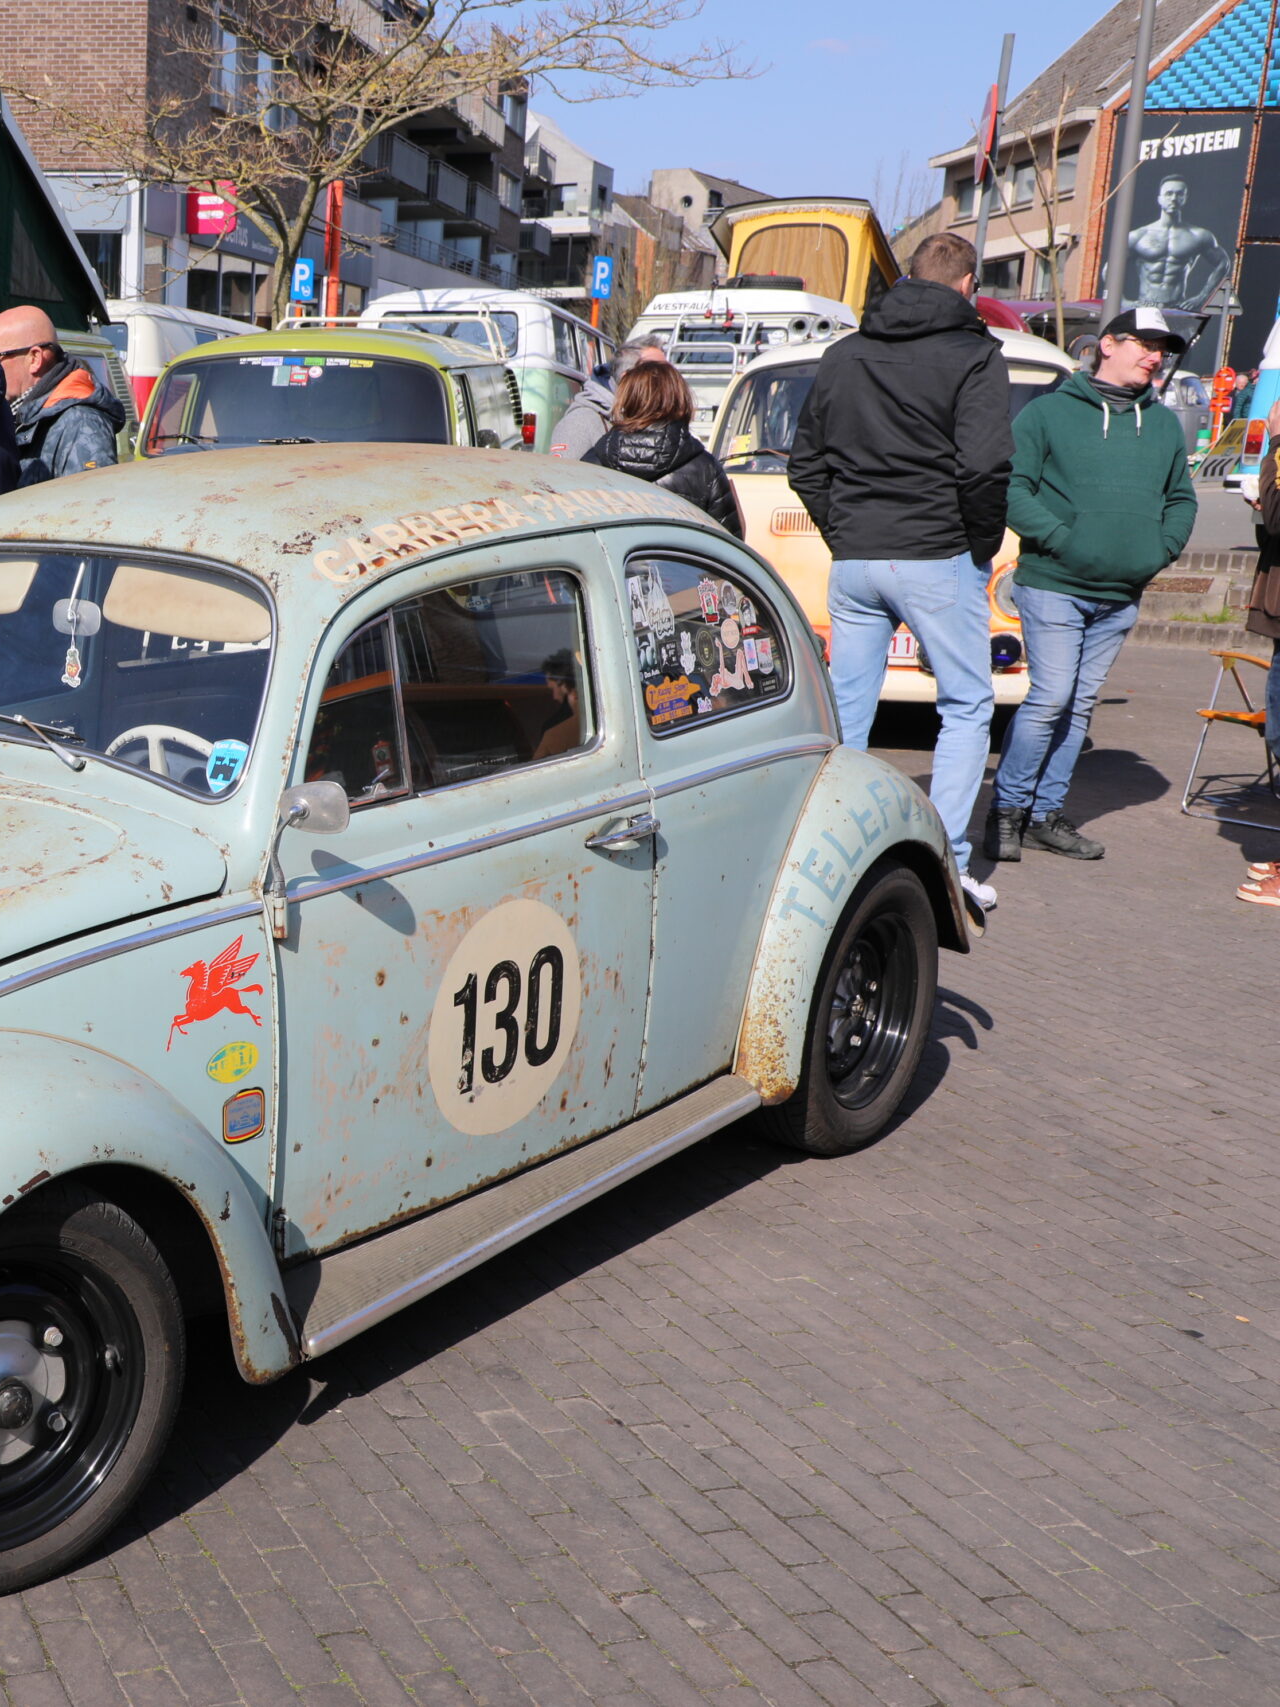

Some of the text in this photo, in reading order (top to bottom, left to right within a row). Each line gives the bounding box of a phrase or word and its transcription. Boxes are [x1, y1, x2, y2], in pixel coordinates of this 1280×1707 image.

[1139, 128, 1241, 160] ET SYSTEEM
[294, 263, 310, 292] P
[596, 261, 609, 290] P
[652, 303, 710, 311] WESTFALIA
[312, 496, 538, 584] CARRERA
[454, 945, 564, 1095] 130
